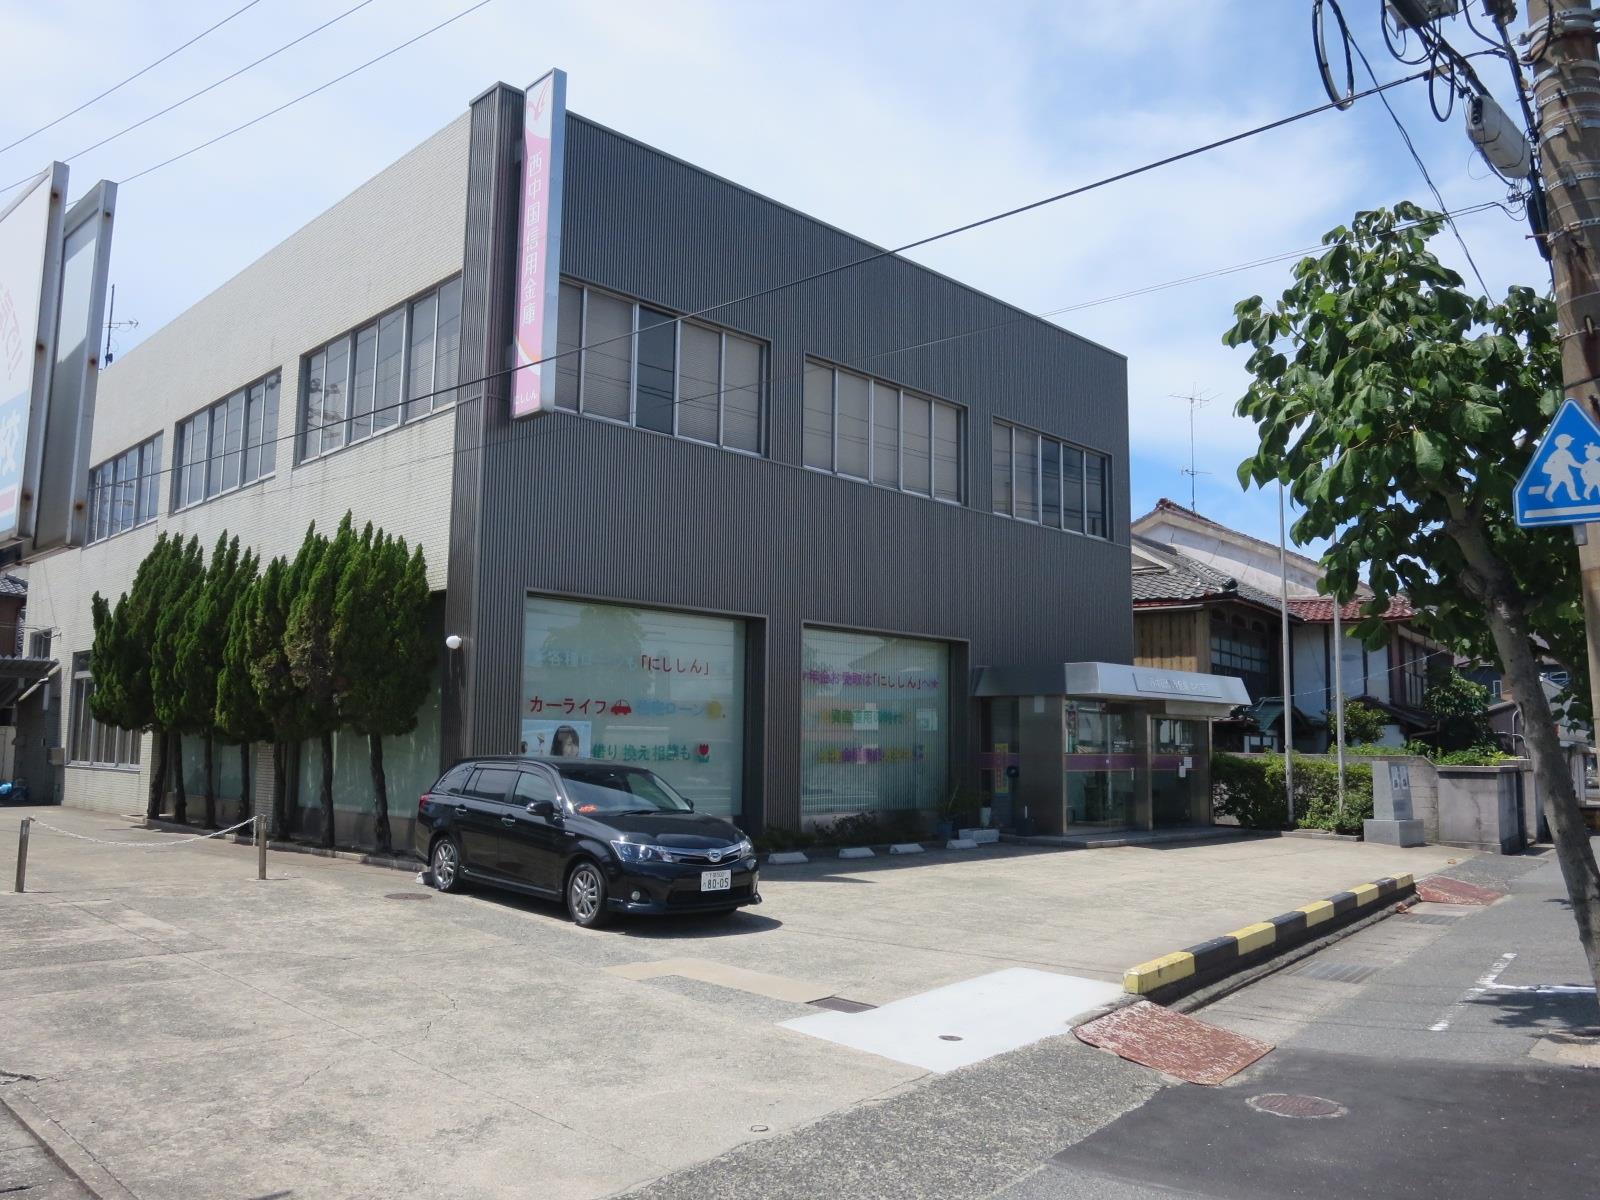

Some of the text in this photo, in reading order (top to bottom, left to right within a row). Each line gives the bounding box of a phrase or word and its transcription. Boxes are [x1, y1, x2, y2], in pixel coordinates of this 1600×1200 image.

[522, 150, 543, 326] 西中国信用金庫
[529, 696, 608, 715] カーライフ
